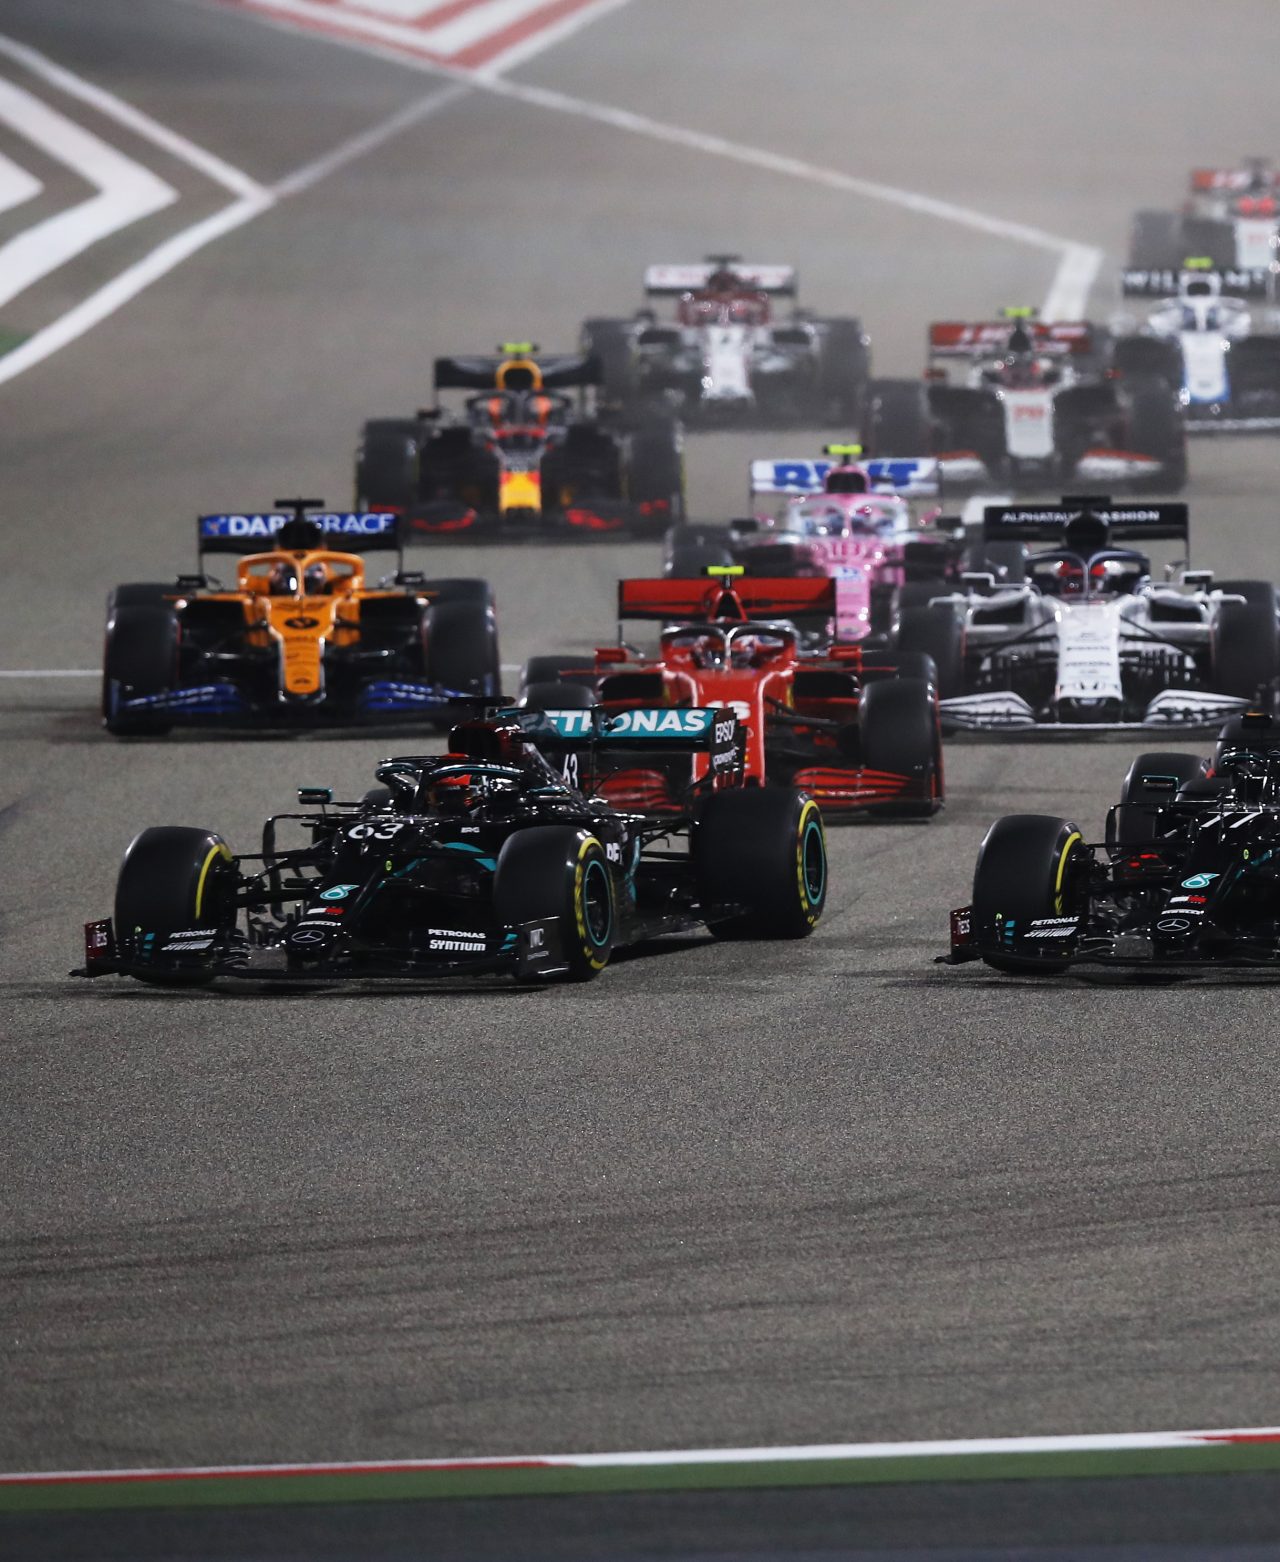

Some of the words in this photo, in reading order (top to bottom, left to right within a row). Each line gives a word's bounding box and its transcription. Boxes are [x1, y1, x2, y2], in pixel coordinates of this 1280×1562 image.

[1001, 511, 1080, 522] ALPHATAU
[347, 822, 405, 840] 63
[1029, 916, 1080, 927] PETRONAS
[168, 928, 218, 939] PETRONAS
[428, 928, 487, 940] PETRONAS
[429, 939, 487, 952] SYNTIUM
